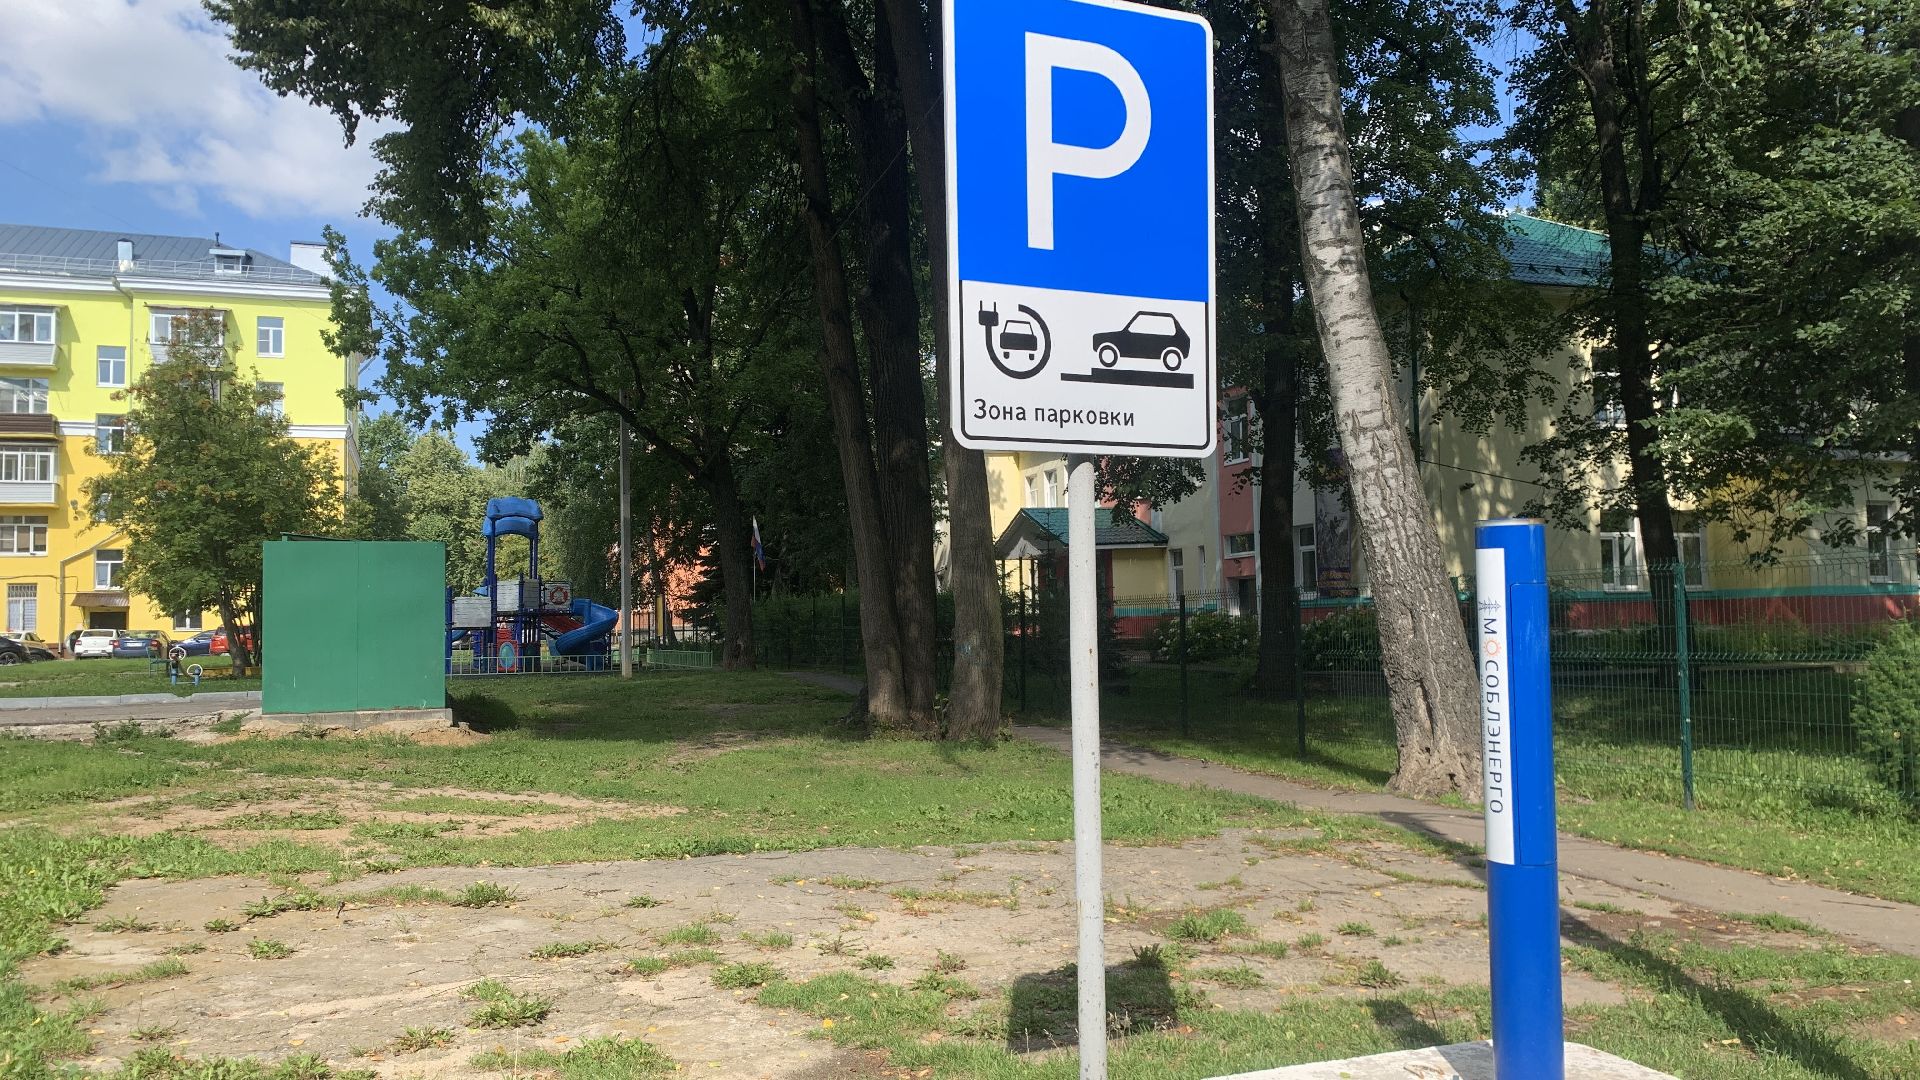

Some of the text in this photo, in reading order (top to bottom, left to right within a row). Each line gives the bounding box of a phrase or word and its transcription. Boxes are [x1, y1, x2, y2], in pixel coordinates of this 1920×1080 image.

[1025, 31, 1152, 251] P
[973, 398, 1135, 428] Зона парковки
[1483, 618, 1504, 814] МОСОБЛЭНЕРГО
